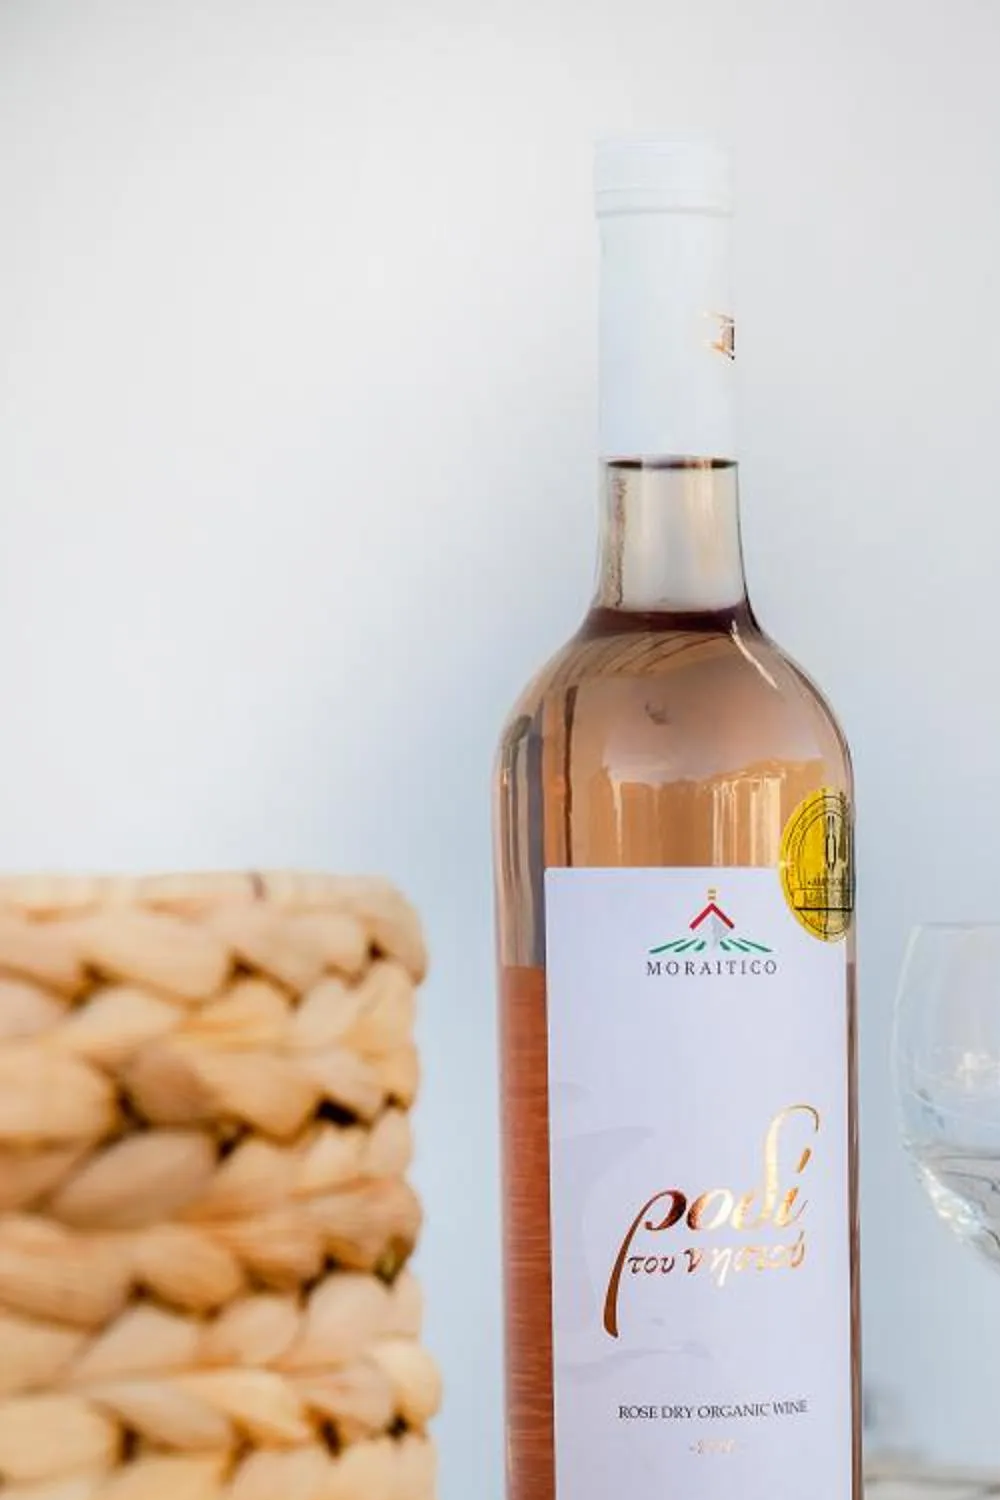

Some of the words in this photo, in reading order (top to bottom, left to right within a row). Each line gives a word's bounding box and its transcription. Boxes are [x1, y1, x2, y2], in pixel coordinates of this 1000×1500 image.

[646, 959, 778, 976] MORAITICO
[628, 1256, 675, 1275] του
[618, 1404, 659, 1420] ROSE
[661, 1404, 694, 1420] DRY
[697, 1402, 771, 1419] ORGANIC
[772, 1399, 808, 1416] WINE
